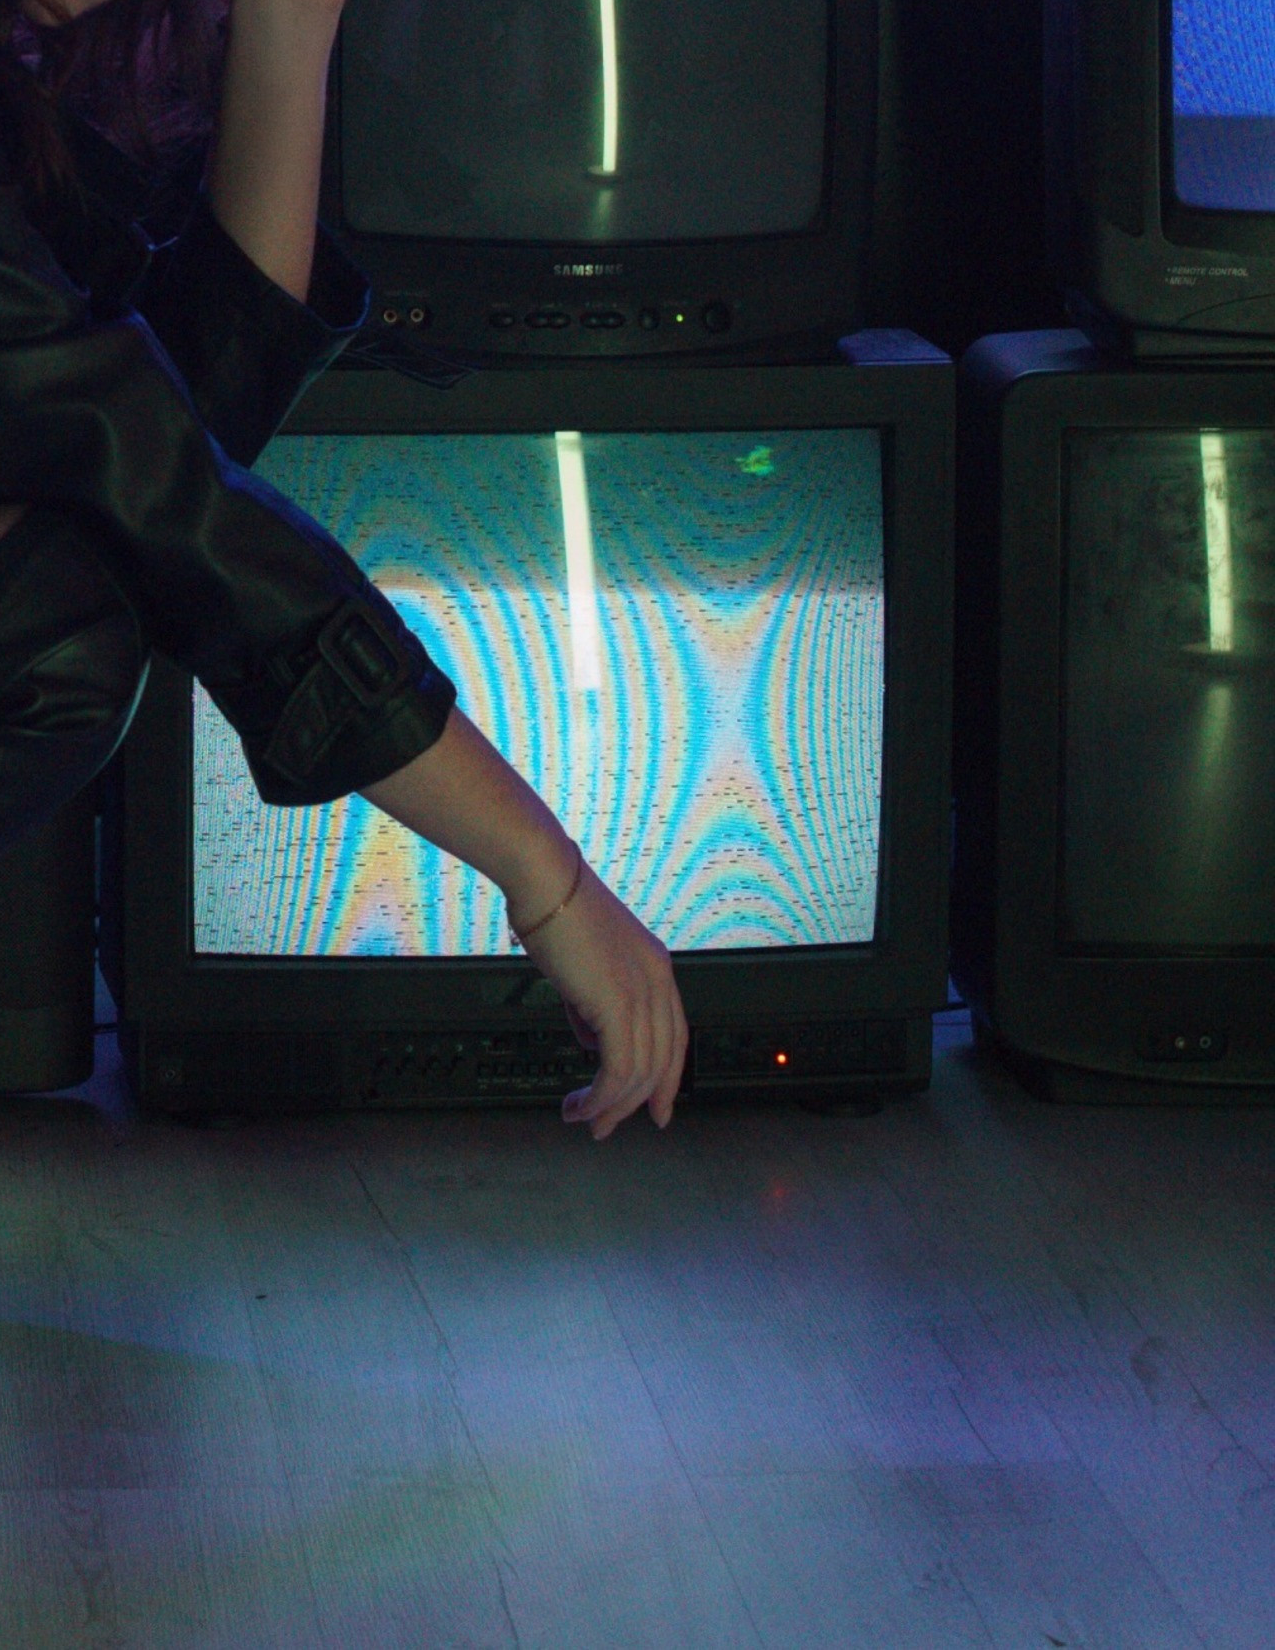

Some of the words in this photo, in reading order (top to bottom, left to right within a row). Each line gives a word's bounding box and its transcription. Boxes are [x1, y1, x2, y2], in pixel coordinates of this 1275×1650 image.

[553, 263, 624, 277] SAMSUNG
[1172, 267, 1206, 276] REMOTE
[1208, 267, 1249, 277] CONTROL
